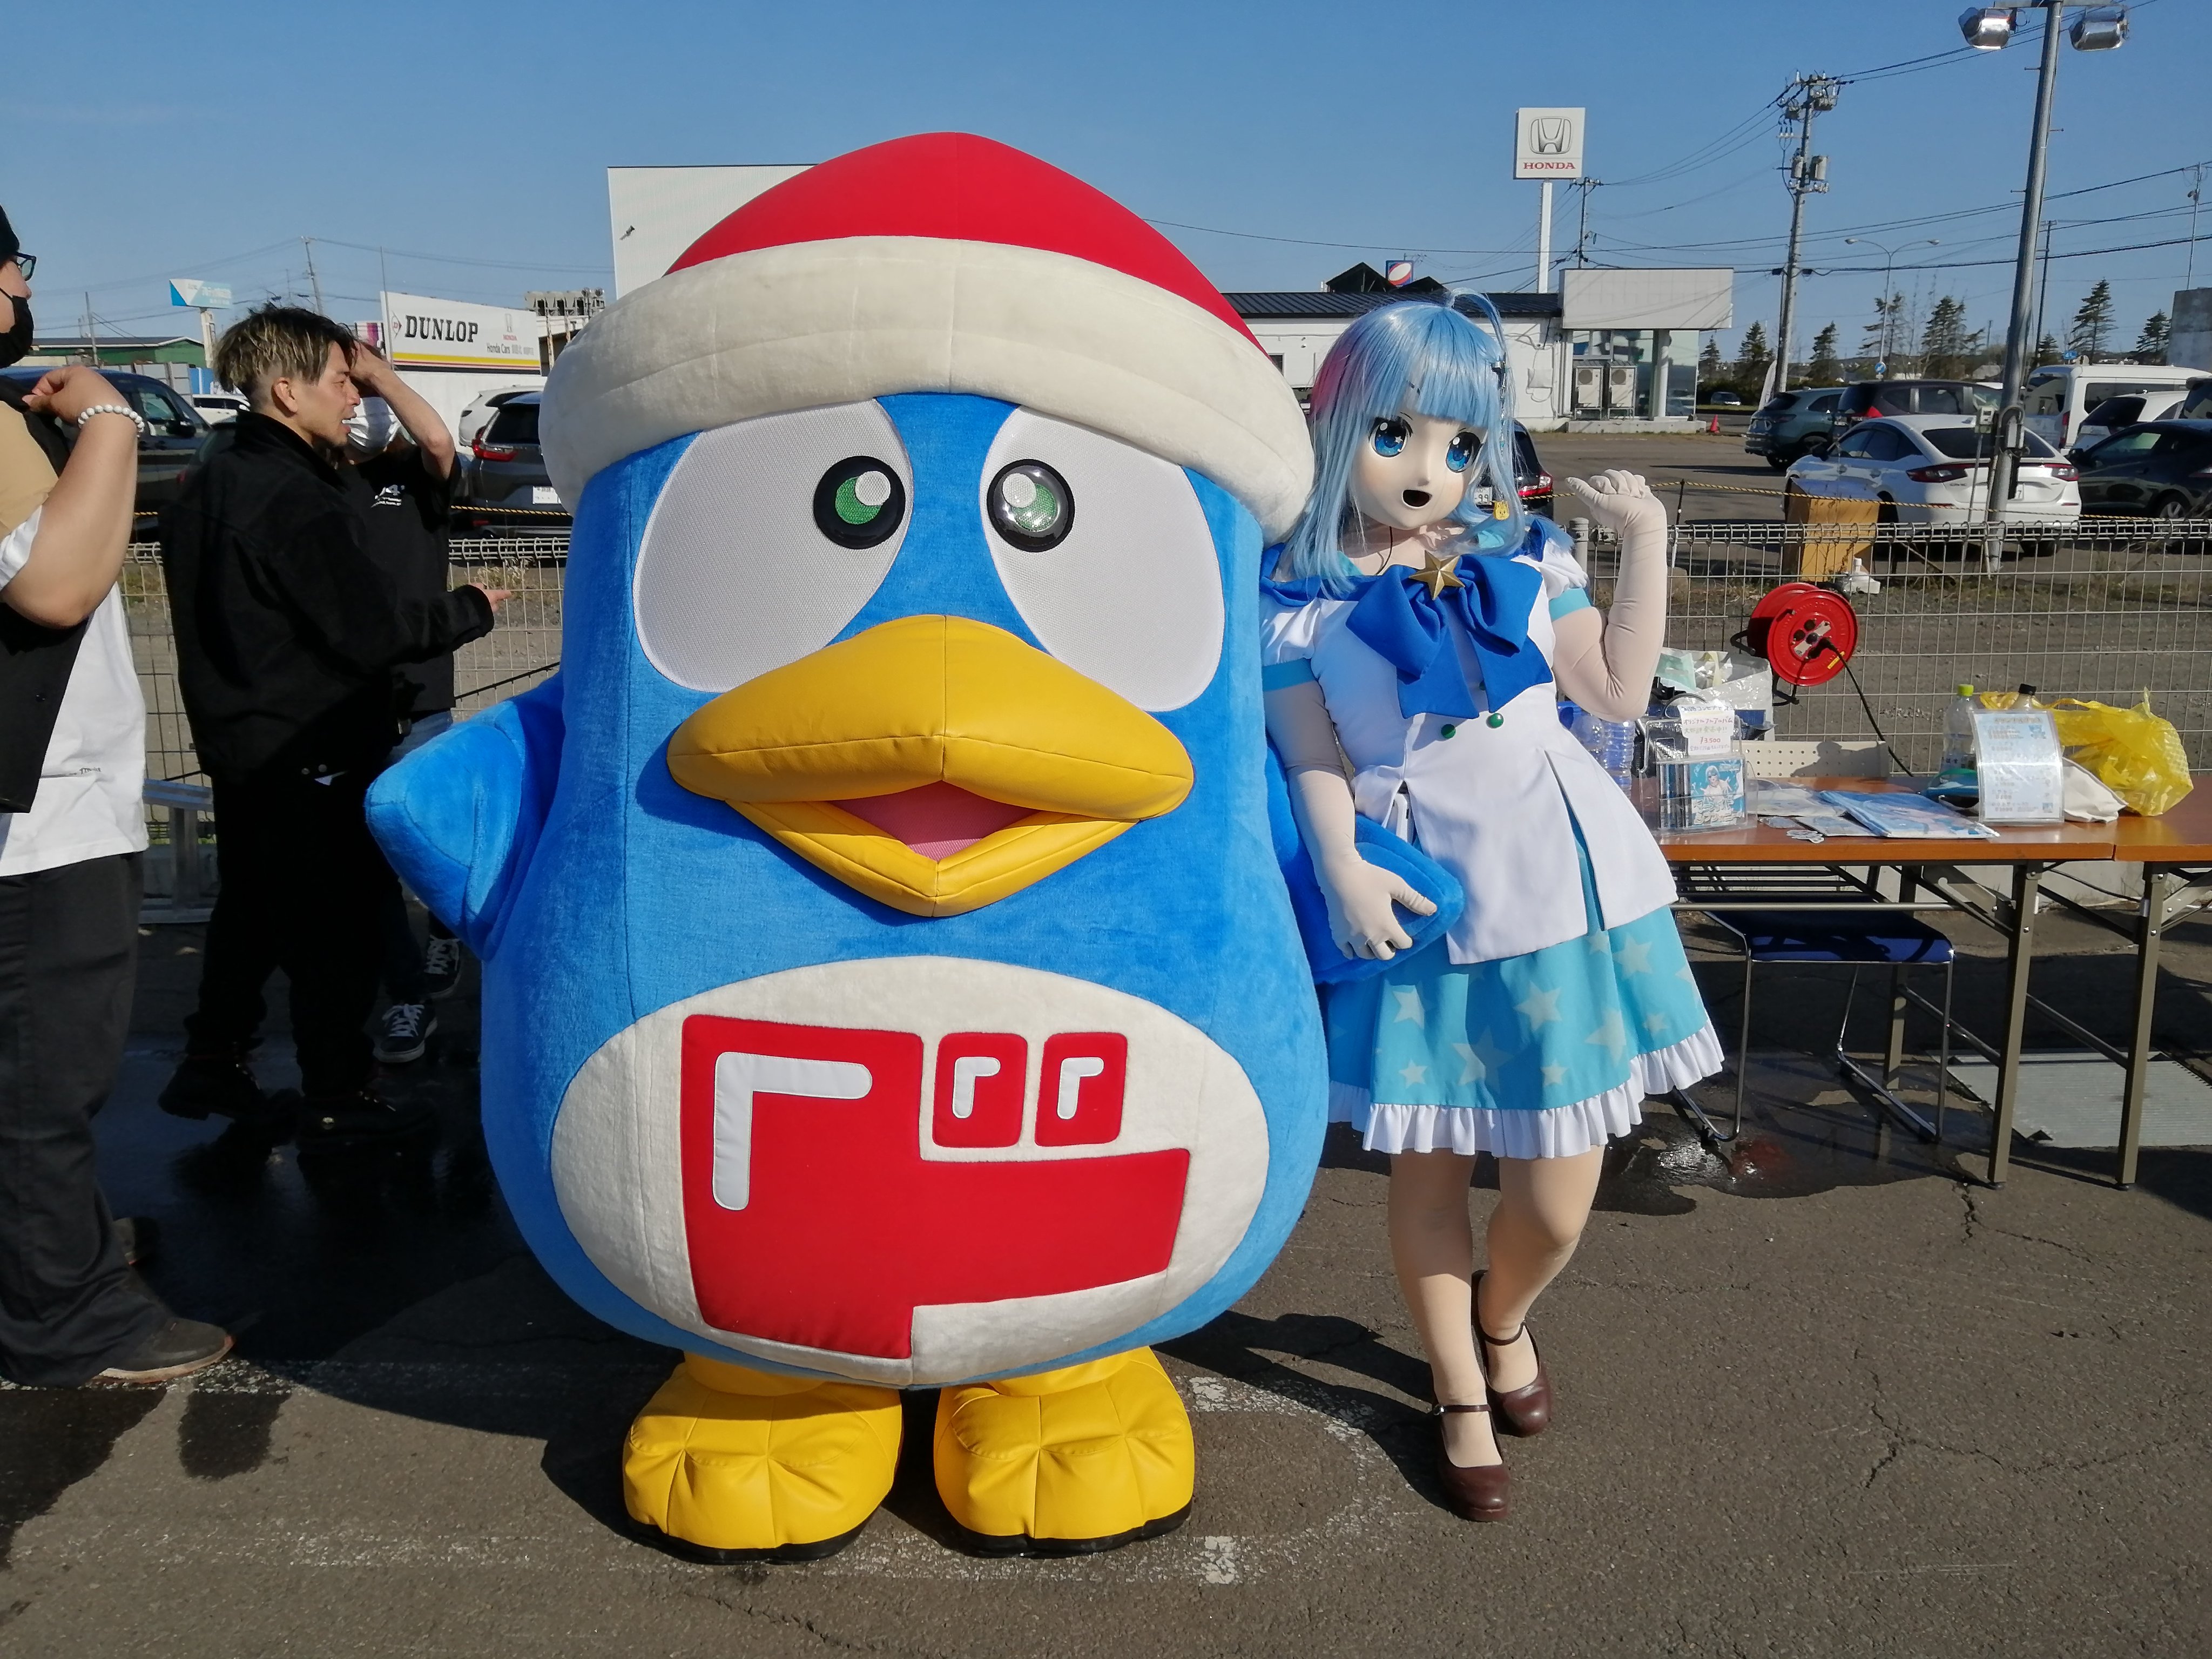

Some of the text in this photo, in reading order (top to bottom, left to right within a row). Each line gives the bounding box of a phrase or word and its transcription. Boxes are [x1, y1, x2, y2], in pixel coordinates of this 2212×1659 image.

[405, 315, 478, 343] DUNLOP
[487, 342, 501, 354] Honda
[501, 343, 510, 354] Cars
